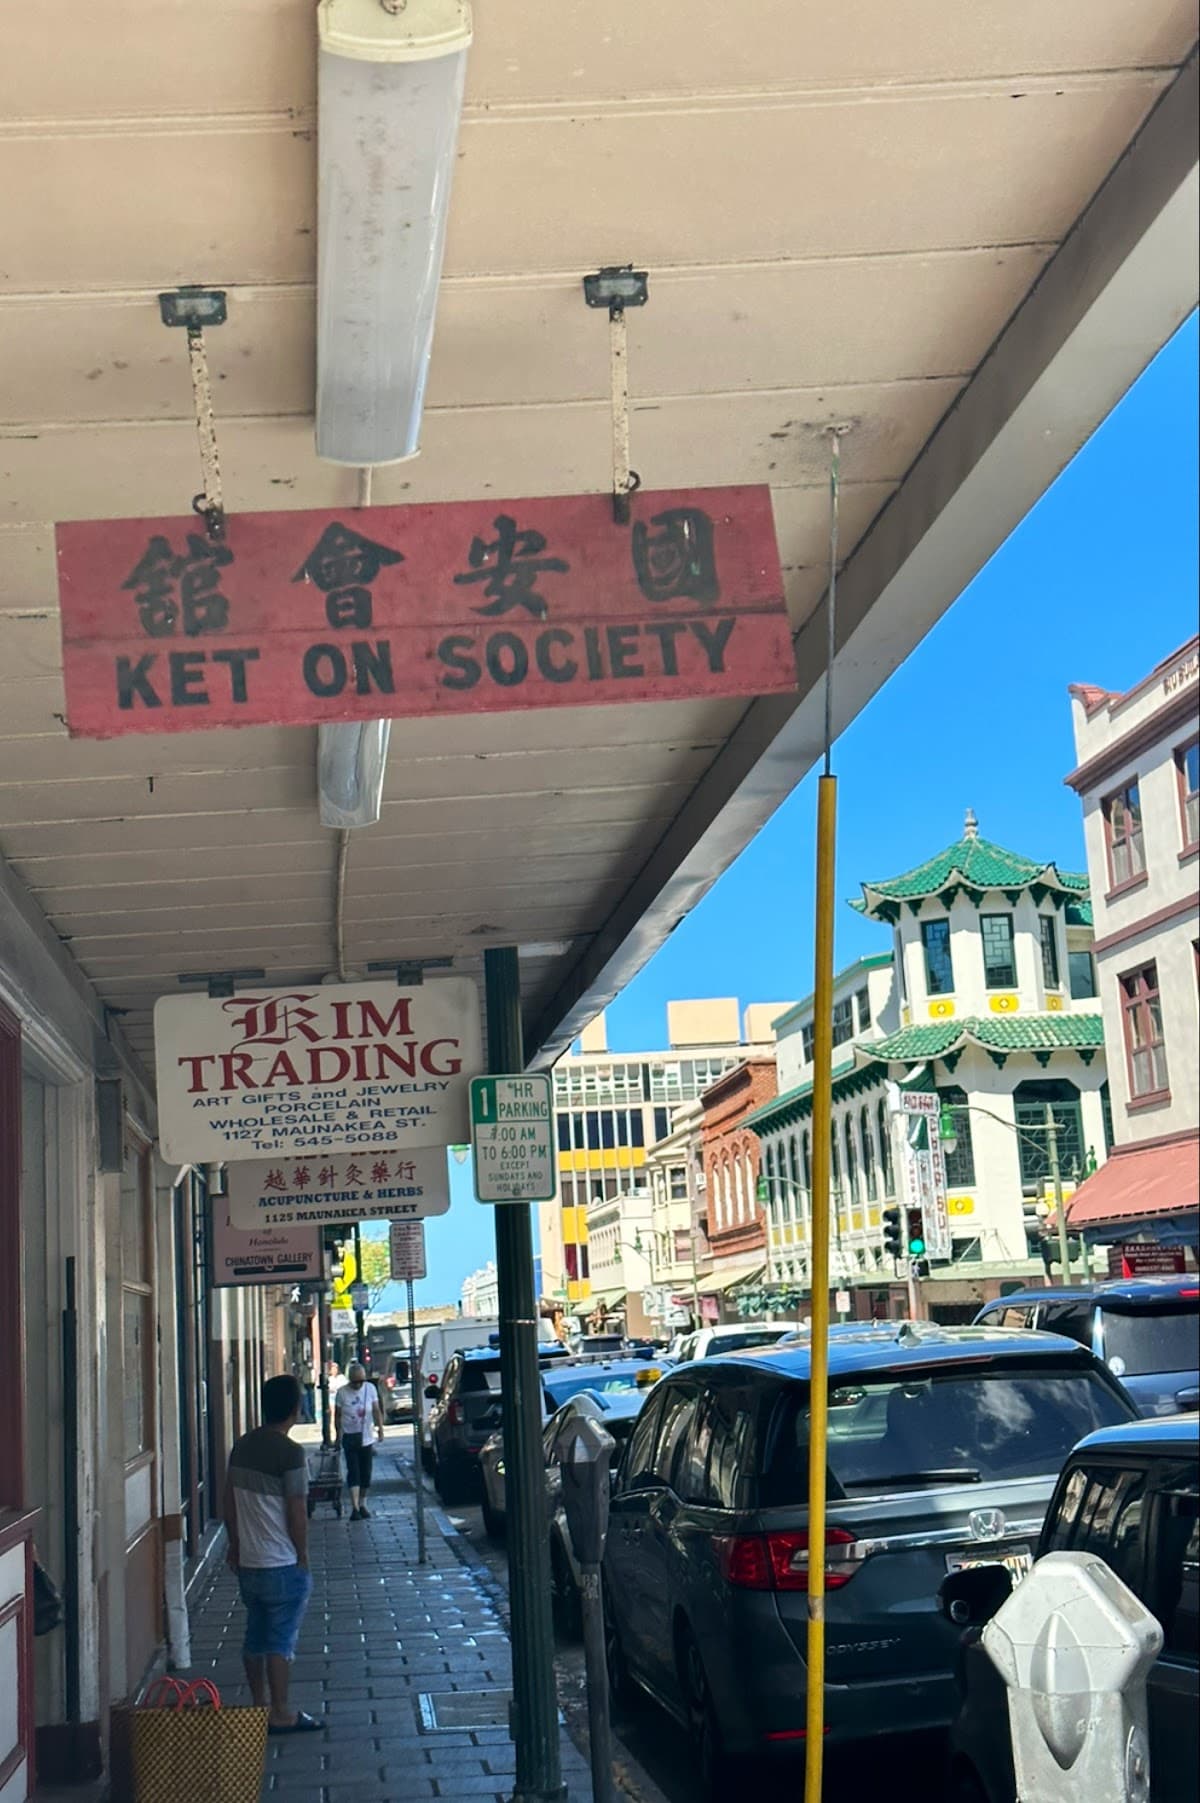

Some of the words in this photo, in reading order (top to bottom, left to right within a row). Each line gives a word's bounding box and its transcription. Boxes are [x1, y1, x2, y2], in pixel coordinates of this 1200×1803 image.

[115, 647, 261, 710] KET
[302, 639, 396, 698] ON
[437, 617, 736, 690] SOCIETY
[178, 1038, 463, 1093] TRADING
[193, 1096, 233, 1108] ART
[242, 1091, 301, 1104] GIFTS
[311, 1088, 347, 1100] and
[356, 1081, 451, 1097] JEWELRY
[480, 1087, 489, 1117] 1
[513, 1082, 534, 1098] HR
[264, 1098, 381, 1114] PORCELAIN
[499, 1102, 548, 1118] PARKING
[209, 1112, 336, 1130] WHOLESALE
[346, 1110, 359, 1120] &
[370, 1105, 437, 1119] RETAIL
[222, 1128, 263, 1141] 1127
[272, 1121, 386, 1137] MAUNAKEA
[395, 1117, 426, 1129] ST.
[520, 1127, 536, 1140] AM
[251, 1139, 284, 1150] Tel:
[294, 1131, 399, 1147] 545-5088
[482, 1146, 496, 1160] TO
[501, 1145, 527, 1159] 6:00
[531, 1144, 547, 1158] PM
[500, 1161, 529, 1170] EXCEPT
[488, 1171, 526, 1182] SUNDAYS
[528, 1171, 543, 1180] AND
[258, 1191, 360, 1207] ACUPUNCTURE
[362, 1189, 374, 1200] &
[377, 1185, 424, 1198] HERBS
[265, 1212, 294, 1223] 1125
[296, 1207, 368, 1221] MAUNAKEA
[370, 1203, 418, 1216] STREET
[225, 1254, 274, 1267] CHINATOWN
[277, 1251, 313, 1264] GALLERY
[826, 1637, 902, 1656] ODYSSEY
